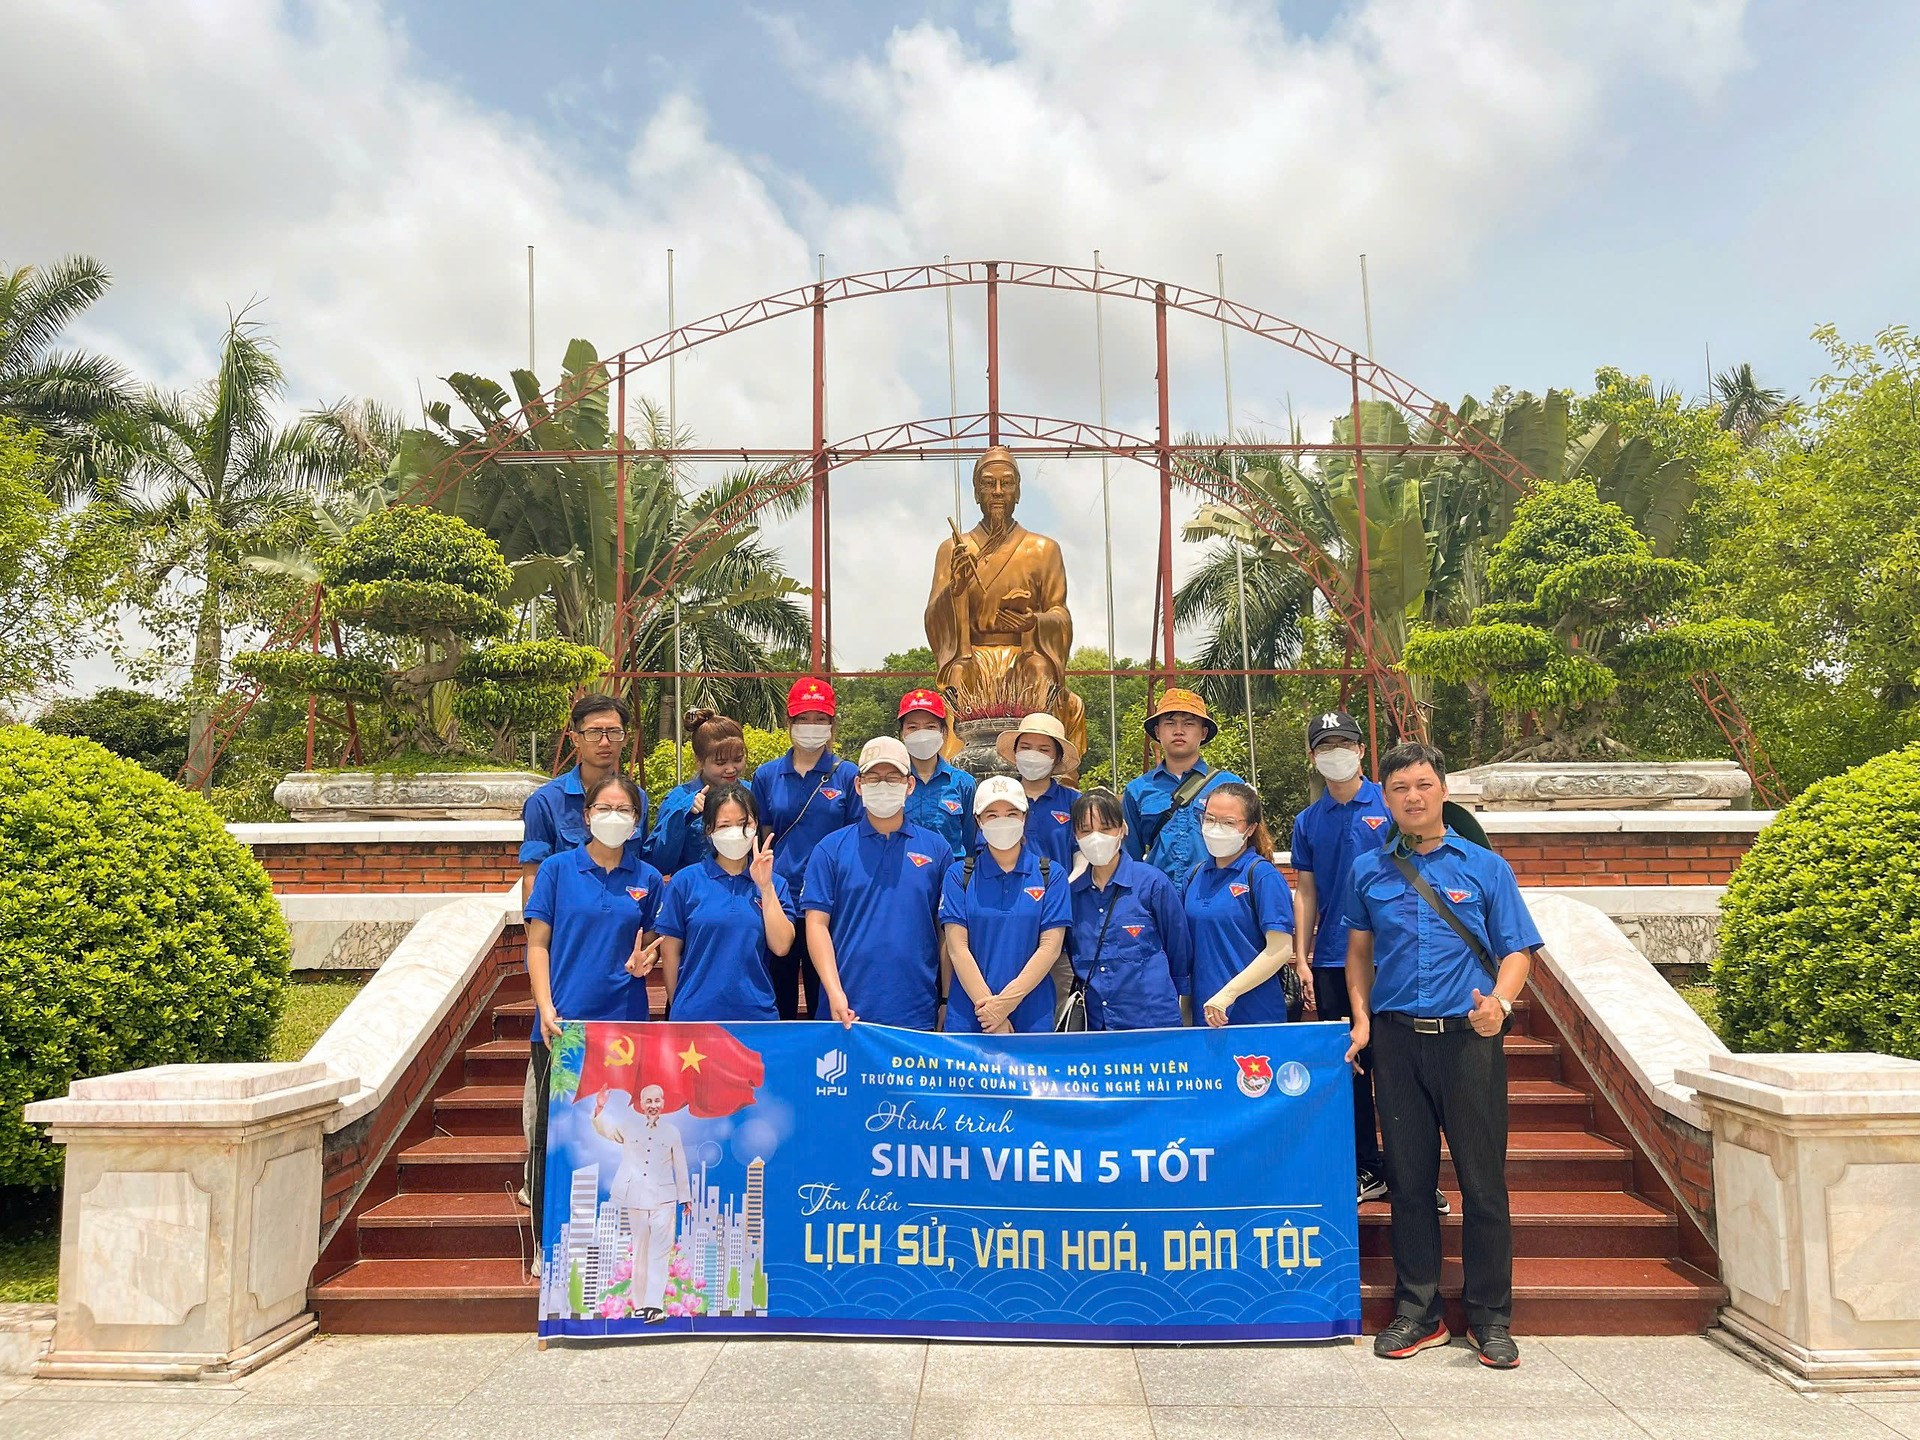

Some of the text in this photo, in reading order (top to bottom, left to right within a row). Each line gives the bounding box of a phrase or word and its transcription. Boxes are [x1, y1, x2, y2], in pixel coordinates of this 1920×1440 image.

[1322, 713, 1341, 729] NY
[891, 1055, 939, 1069] ĐOÀN
[945, 1058, 1001, 1074] THANH
[1008, 1062, 1048, 1076] NIÊN
[1067, 1062, 1097, 1078] HỘI
[1104, 1063, 1143, 1076] SINH
[1149, 1060, 1189, 1075] VIÊN
[816, 1086, 848, 1096] HPU
[861, 1072, 914, 1086] TRƯỜNG
[919, 1075, 942, 1090] ĐẠI
[948, 1077, 974, 1091] HỌC
[980, 1076, 1017, 1090] QUẢN
[1041, 1080, 1058, 1092] VÀ
[1064, 1080, 1100, 1093] CÔNG
[1105, 1079, 1141, 1094] NGHỆ
[1147, 1077, 1170, 1092] HẢI
[1176, 1078, 1223, 1091] PHÒNG
[865, 1100, 1015, 1133] Hành trình
[871, 1137, 1215, 1184] SINH VIÊN 5 TỐT
[798, 1181, 903, 1216] Tìm hiểu
[804, 1216, 1322, 1276] LỊCH SỬ, VĂN HOÁ, DÂN TỘC
